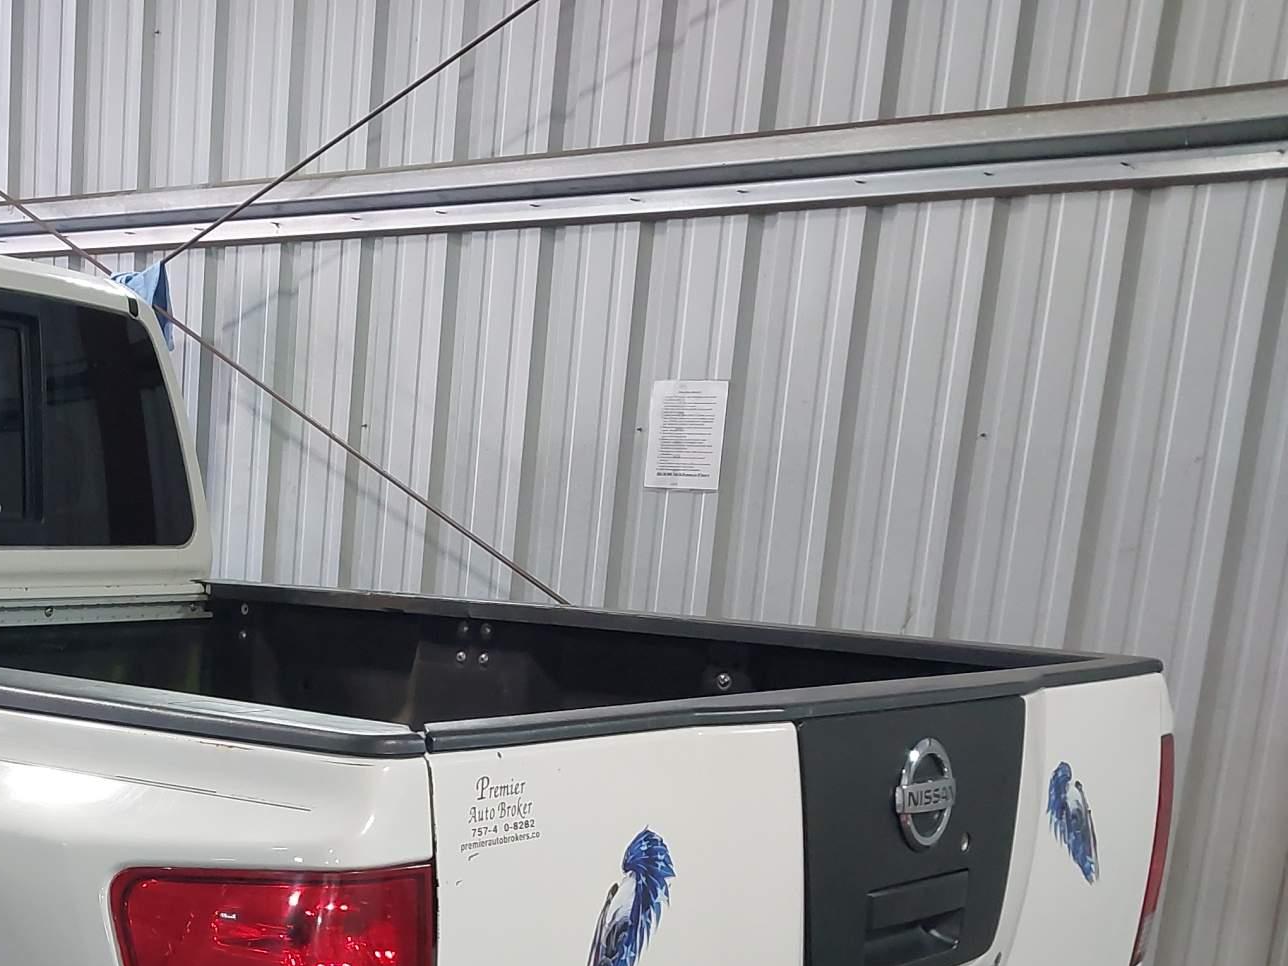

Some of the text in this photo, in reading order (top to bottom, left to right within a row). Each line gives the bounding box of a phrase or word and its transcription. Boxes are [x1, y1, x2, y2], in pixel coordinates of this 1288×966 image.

[476, 775, 526, 801] Premier
[468, 797, 533, 824] Auto Broker
